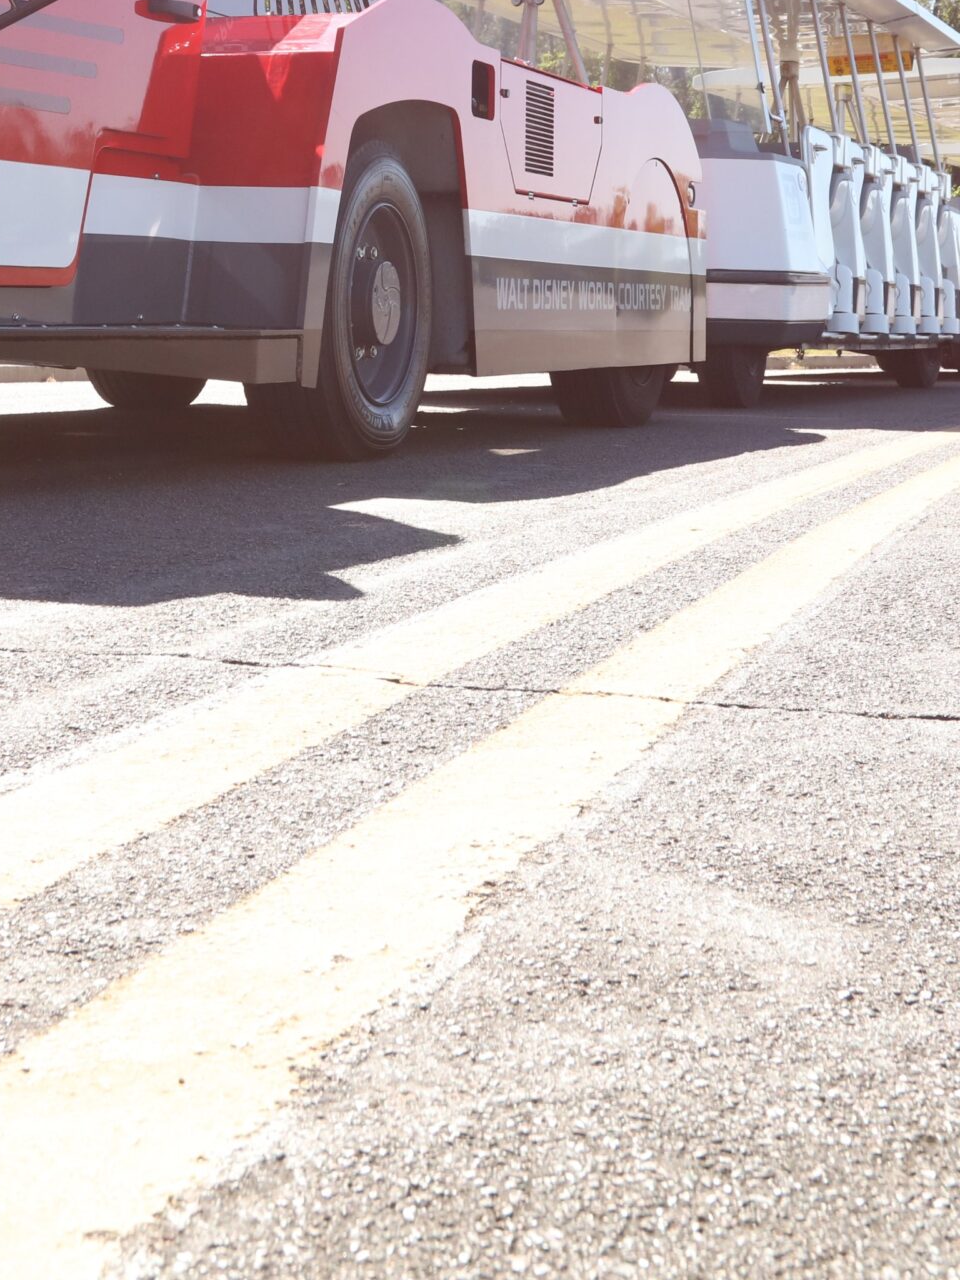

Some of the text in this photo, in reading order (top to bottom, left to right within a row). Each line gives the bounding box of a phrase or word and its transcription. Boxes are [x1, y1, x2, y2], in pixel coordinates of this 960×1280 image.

[496, 277, 691, 312] WALT DISNEY WORLD COURTESY TRAM
